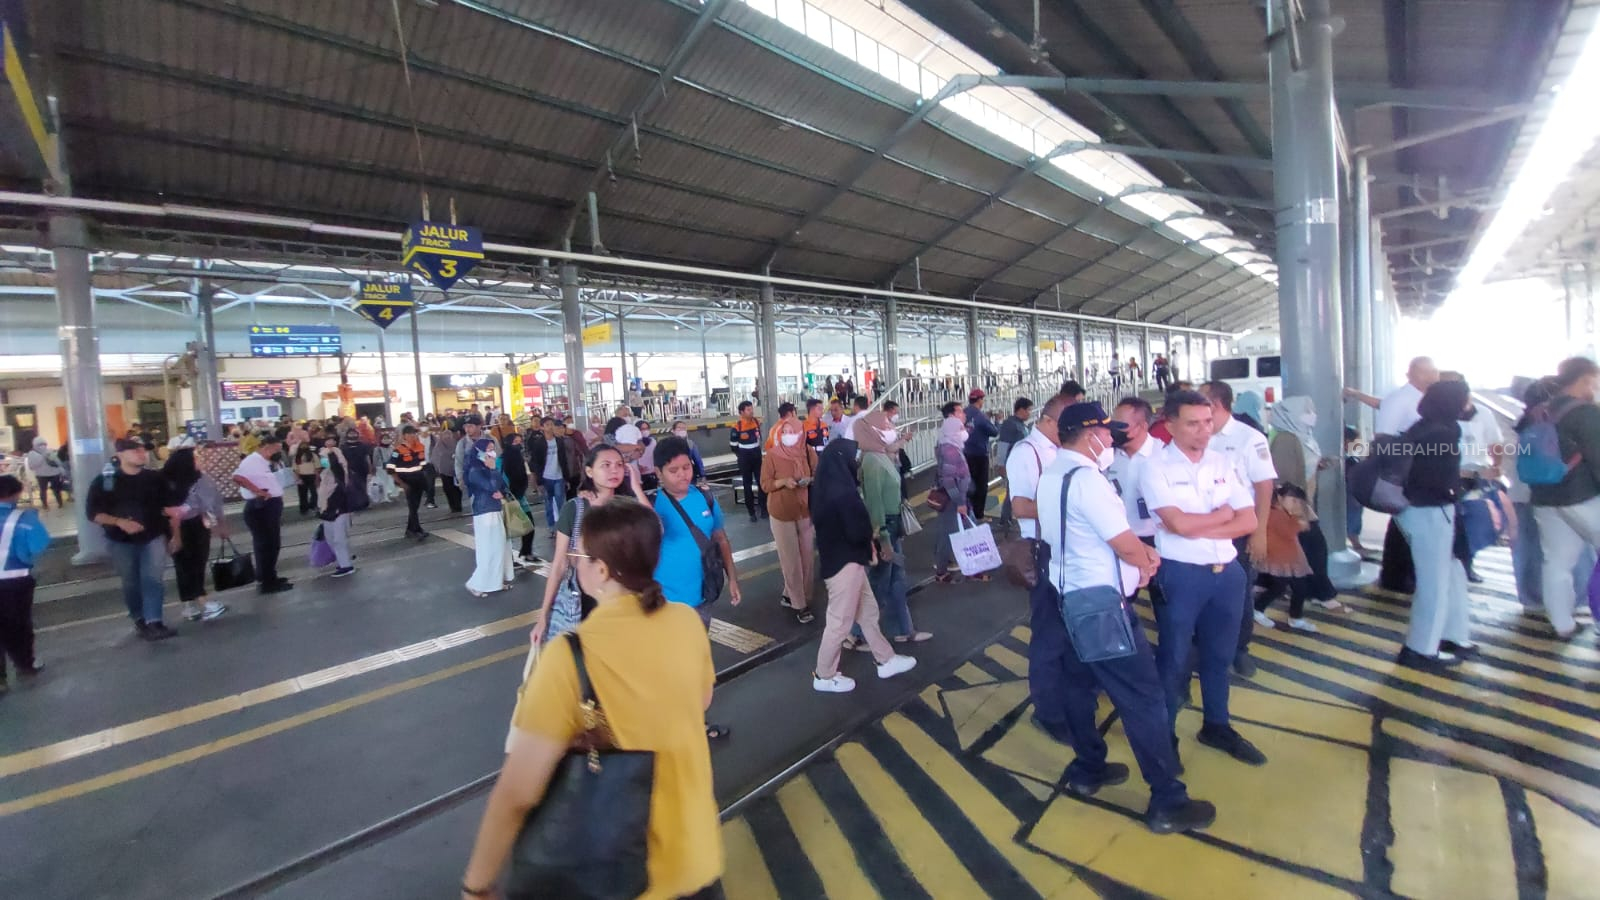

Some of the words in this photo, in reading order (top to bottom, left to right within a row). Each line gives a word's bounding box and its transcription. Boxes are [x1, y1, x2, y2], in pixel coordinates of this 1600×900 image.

[419, 224, 469, 242] JALUR
[420, 237, 452, 249] TRACK
[439, 258, 458, 278] 3
[362, 283, 401, 294] JALUR
[363, 292, 388, 300] TRACK
[379, 307, 394, 320] 4
